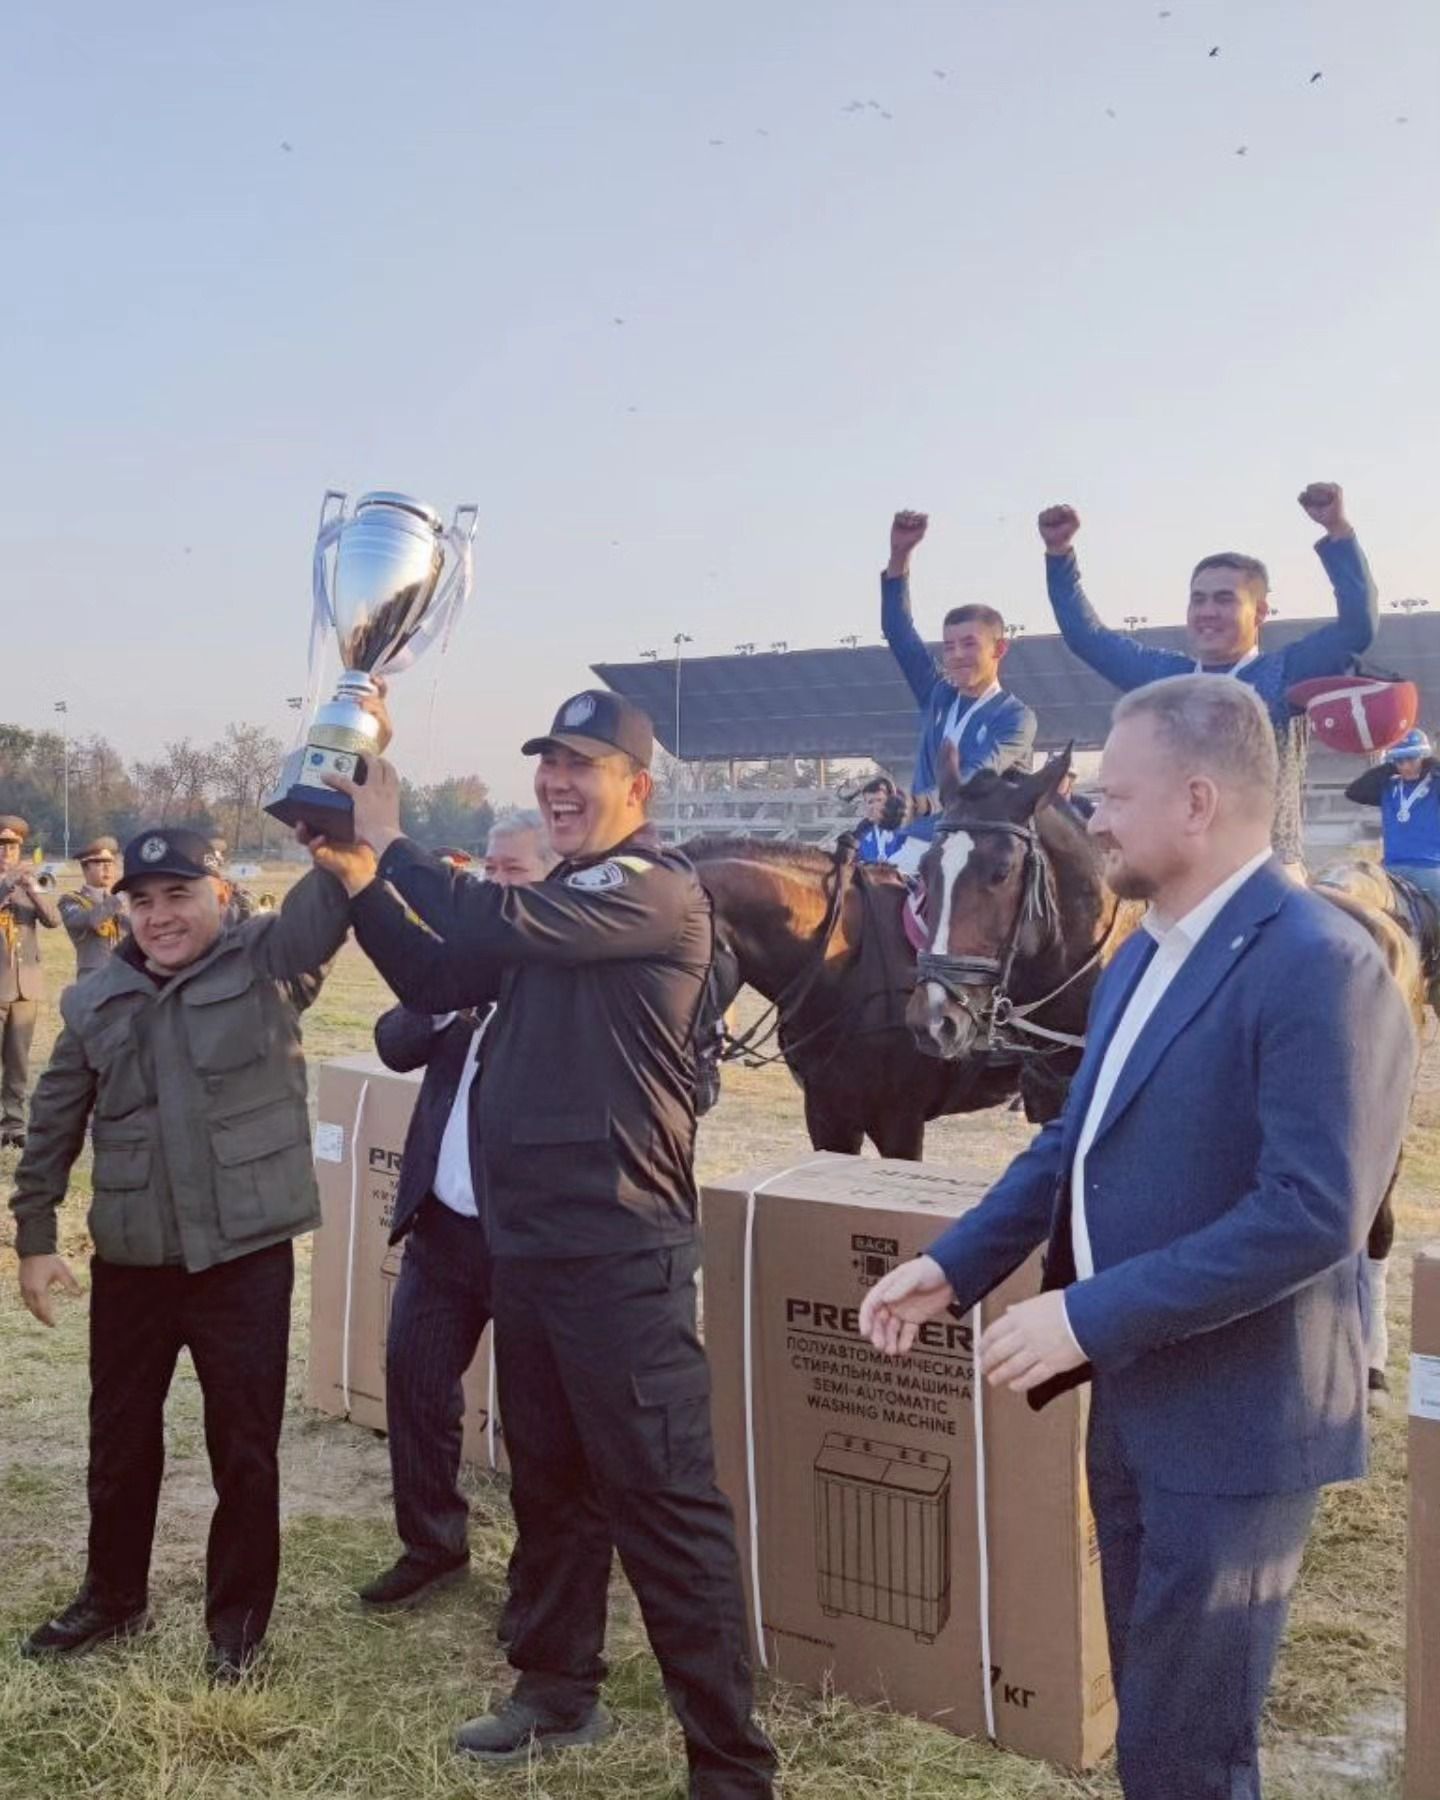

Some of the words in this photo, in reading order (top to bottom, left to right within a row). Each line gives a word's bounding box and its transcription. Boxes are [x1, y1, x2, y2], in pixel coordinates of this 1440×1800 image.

[854, 1237, 895, 1254] BACK
[786, 1299, 973, 1352] PREER
[792, 1355, 892, 1386] СТИРАЛЬНАЯ
[897, 1374, 972, 1399] МАШИНА
[813, 1377, 948, 1414] SEMI-AUTOMATIC
[808, 1395, 878, 1420] WASHING
[883, 1409, 957, 1435] MACHINE
